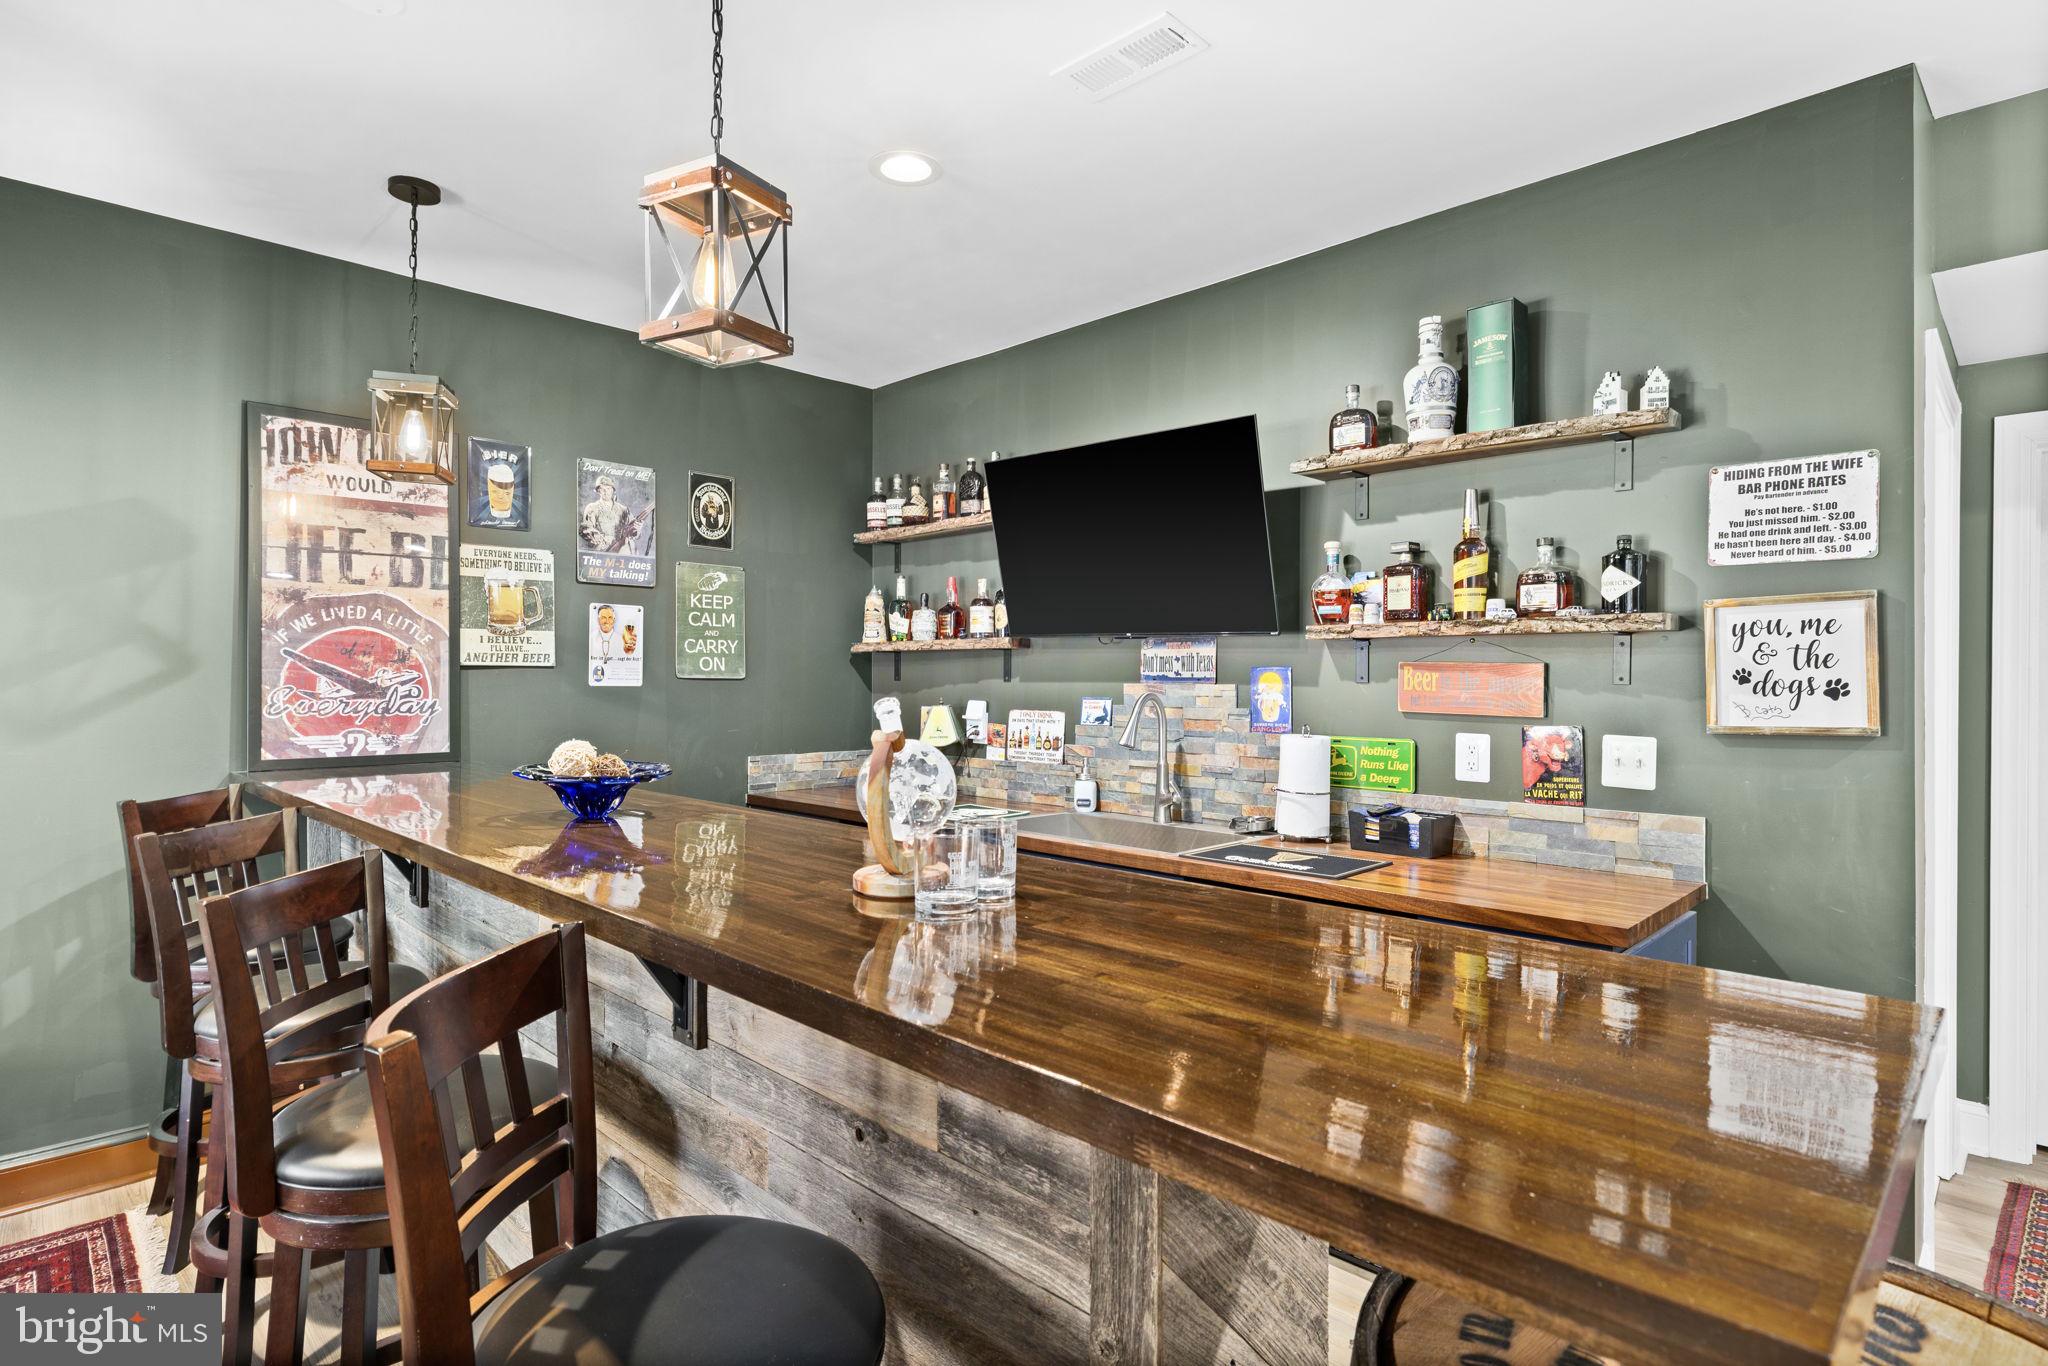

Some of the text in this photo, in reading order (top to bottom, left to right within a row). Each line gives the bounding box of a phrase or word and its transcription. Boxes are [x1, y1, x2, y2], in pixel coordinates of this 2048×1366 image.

[1473, 333, 1508, 348] JAMESON
[482, 449, 519, 465] BIER
[604, 466, 624, 477] Tread
[1724, 457, 1864, 482] HIDING FROM THE WIFE
[326, 474, 392, 494] WOULD
[1738, 474, 1846, 495] BAR PHONE RATES
[1765, 491, 1794, 499] Bartender
[1803, 488, 1828, 496] advance
[1745, 507, 1763, 517] He's
[1765, 506, 1780, 515] not
[1782, 504, 1805, 514] here.
[1812, 501, 1838, 512] $1.00
[1729, 520, 1744, 529] You
[1746, 518, 1763, 528] just
[1765, 516, 1798, 526] missed
[1800, 514, 1820, 523] him.
[1828, 511, 1855, 521] $2.00
[1718, 531, 1729, 539] He
[1731, 529, 1747, 538] had
[1749, 529, 1766, 537] one
[1768, 526, 1791, 536] drink
[1794, 524, 1811, 534] and
[1813, 523, 1832, 533] left.
[1839, 521, 1867, 531] $3.00
[1714, 542, 1725, 550] He
[1727, 539, 1753, 549] hasn't
[1755, 537, 1778, 547] been
[1780, 536, 1801, 545] here
[1803, 535, 1815, 544] all
[1817, 533, 1836, 544] day.
[1843, 532, 1871, 542] $4.00
[474, 549, 543, 561] EVERYONE NEEDS...
[1730, 550, 1756, 559] Never
[1758, 548, 1784, 558] heard
[1786, 547, 1795, 556] of
[1797, 546, 1817, 555] him.
[1824, 544, 1852, 554] $5.00
[460, 557, 501, 569] SOMETHING
[504, 560, 512, 571] TO
[514, 561, 542, 573] BELIEVE
[582, 555, 651, 571] The M-1 does
[588, 567, 649, 582] MY talking!
[690, 593, 733, 610] KEEP
[273, 605, 434, 645] IF WE LIVED A LITTLE
[688, 611, 735, 628] CALM
[480, 635, 542, 645] I BELIEVE...
[1732, 617, 1842, 653] you, me
[505, 645, 530, 653] HAVE...
[684, 638, 738, 654] CARRY
[1165, 641, 1191, 649] TEXAS
[465, 652, 551, 663] ANOTHER BEER
[1159, 655, 1173, 672] mess
[1181, 652, 1194, 672] with
[1196, 652, 1214, 672] Texas
[1752, 639, 1839, 671] & the
[699, 656, 725, 671] ON
[1403, 665, 1439, 692] Beer
[1752, 669, 1820, 711] dogs
[264, 685, 442, 725] Everyday
[1360, 746, 1400, 759] Nothing
[1360, 759, 1409, 771] Runs Like
[1360, 773, 1400, 784] a Deere
[1532, 789, 1558, 799] VACHE
[1569, 790, 1583, 800] RIT
